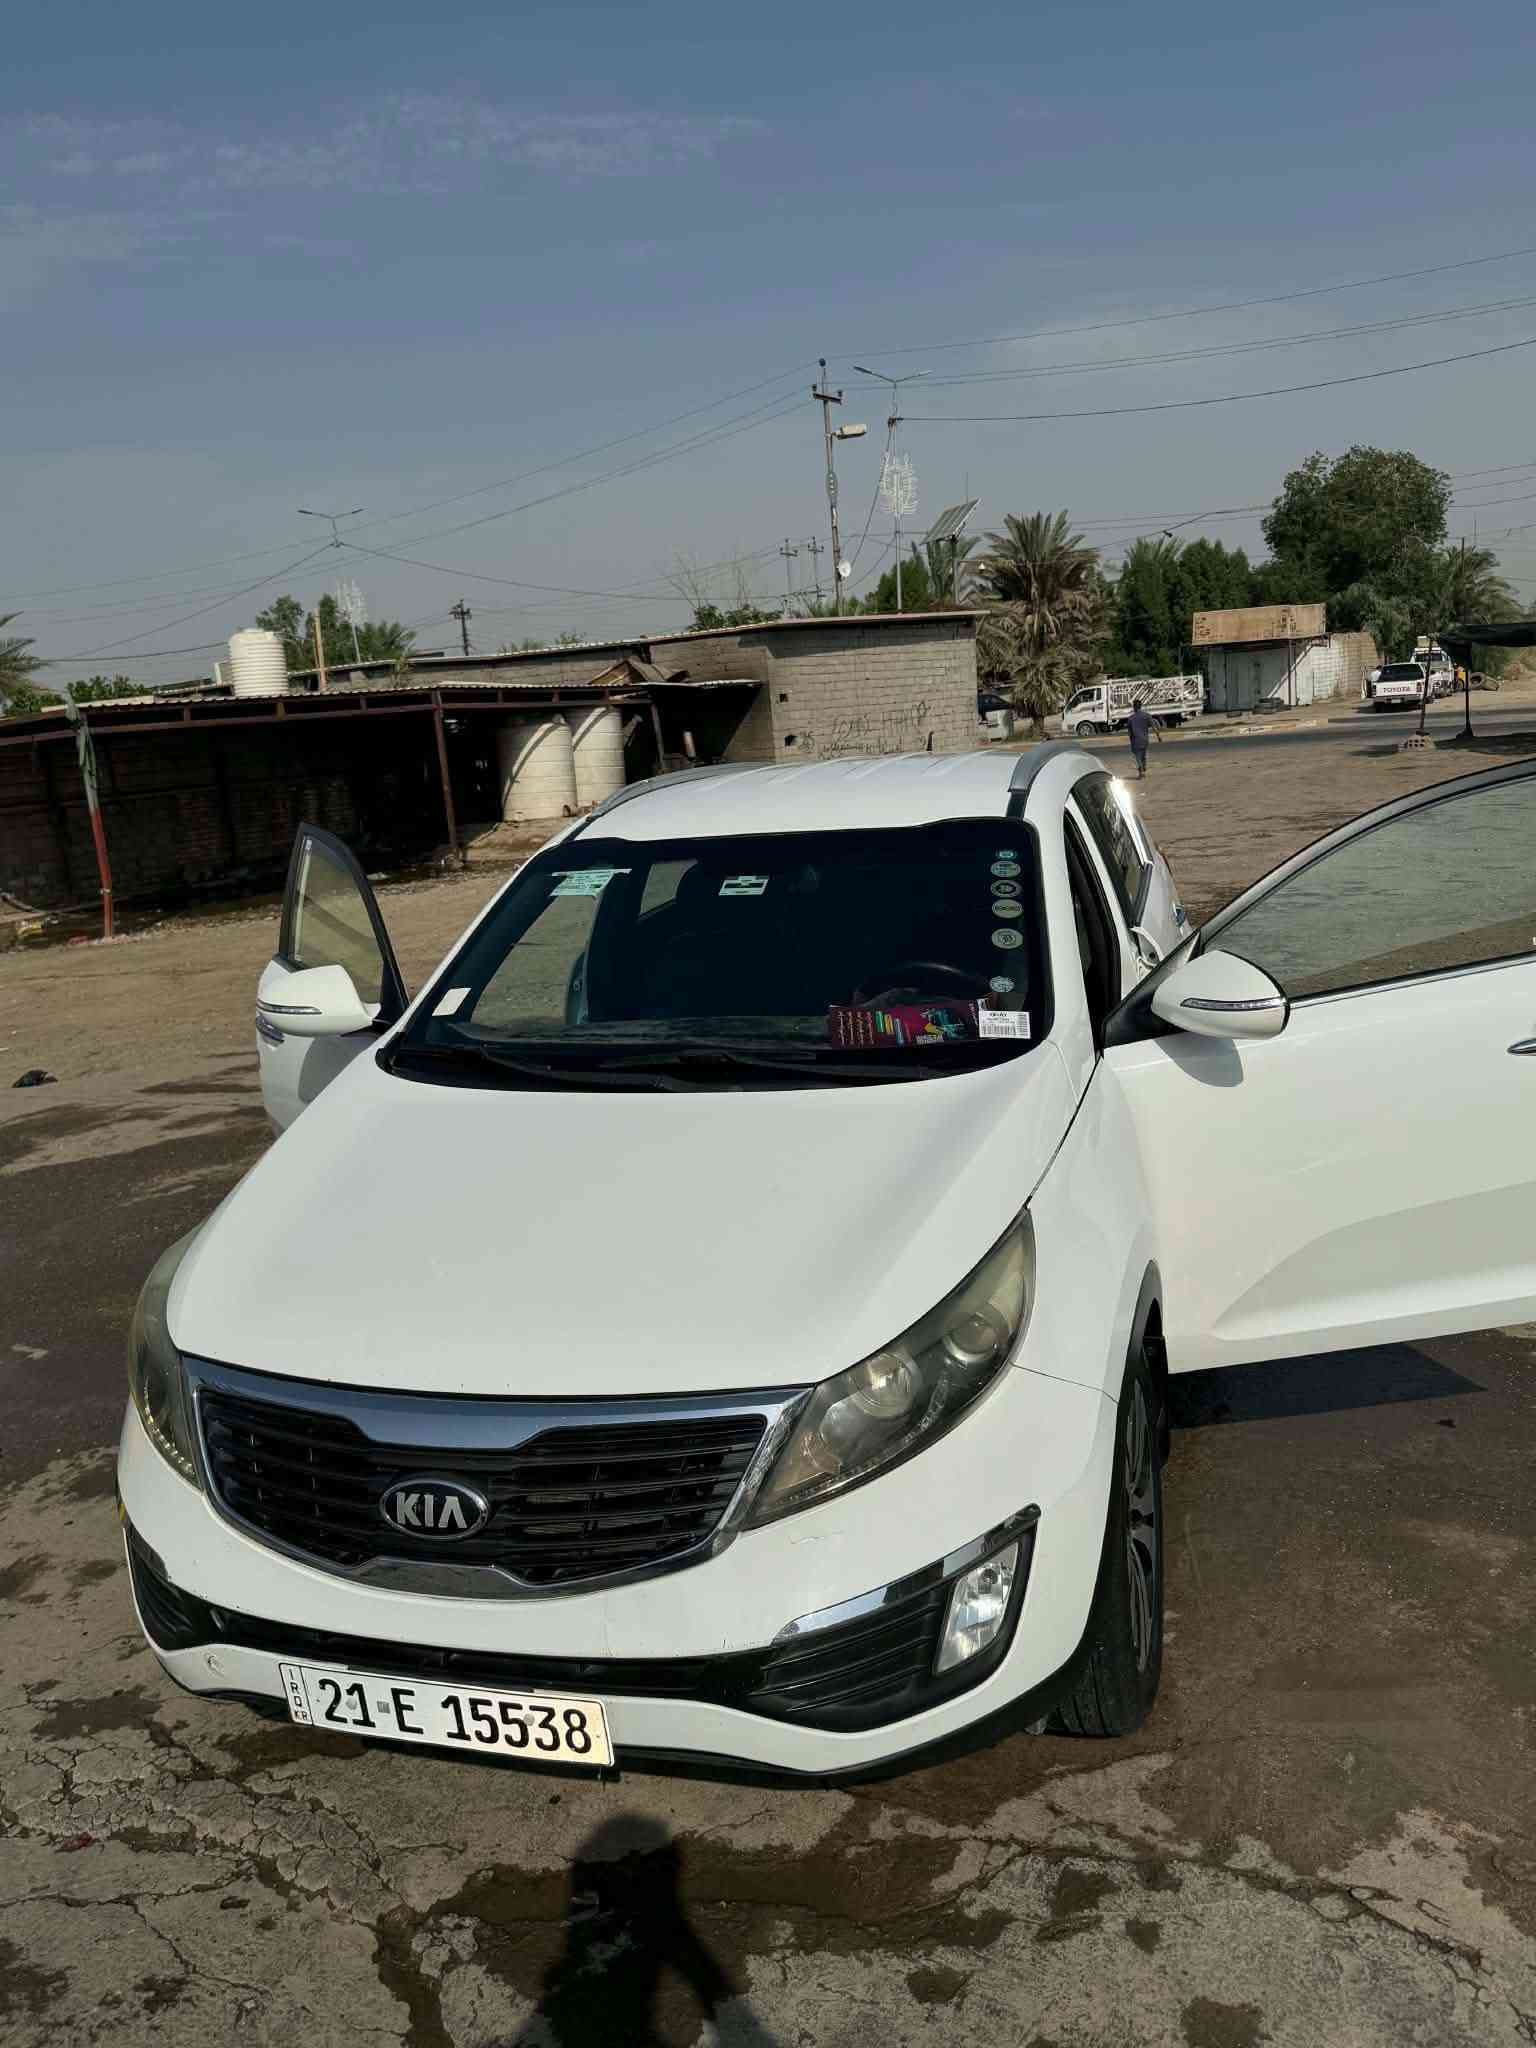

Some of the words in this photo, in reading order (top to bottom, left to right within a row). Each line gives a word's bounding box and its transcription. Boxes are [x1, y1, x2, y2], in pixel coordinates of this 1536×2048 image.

[396, 1491, 467, 1529] KIA
[318, 1678, 376, 1728] 21
[390, 1687, 424, 1735] E
[440, 1694, 592, 1754] 15538
